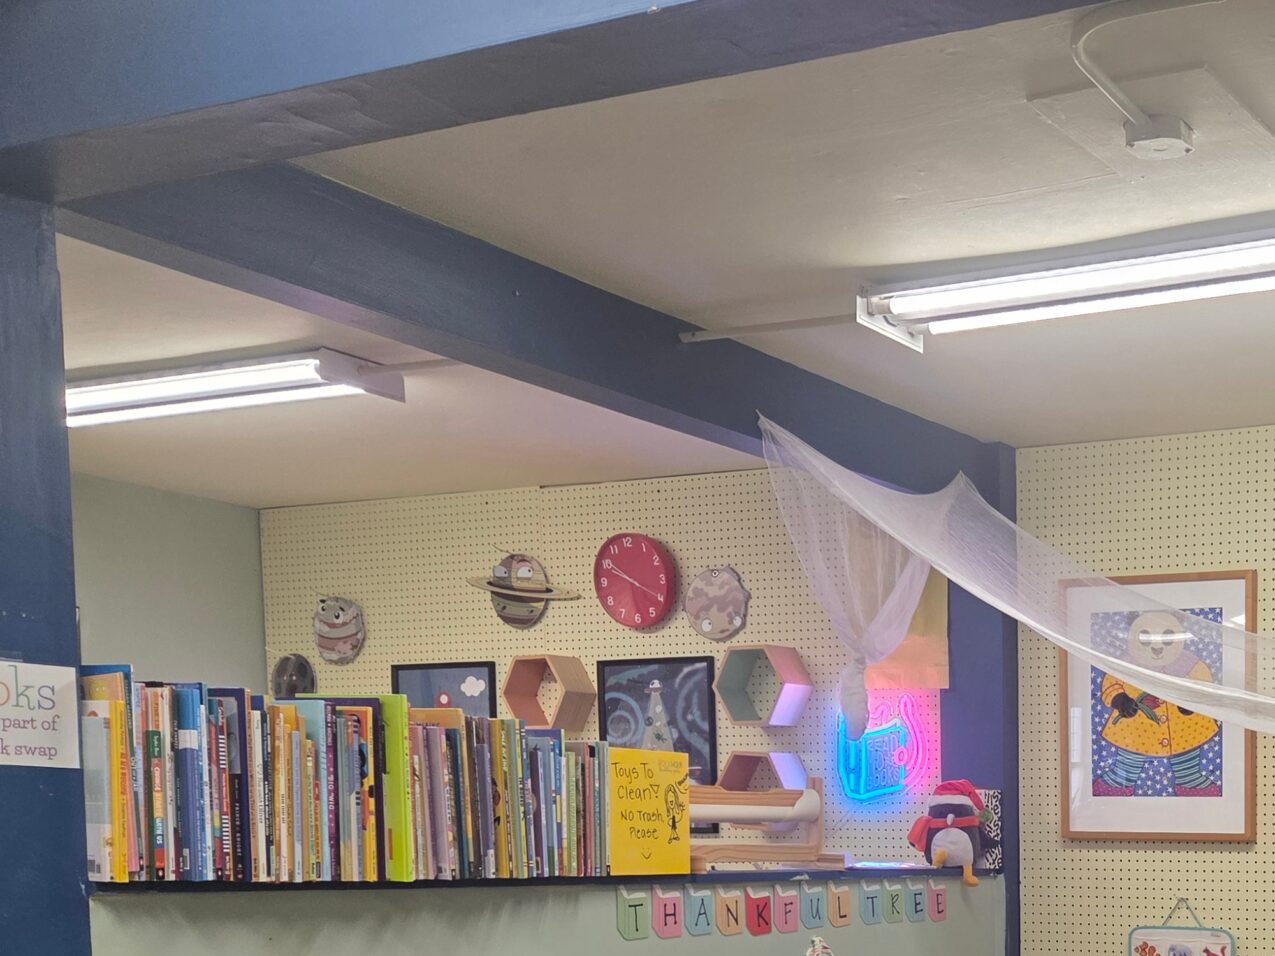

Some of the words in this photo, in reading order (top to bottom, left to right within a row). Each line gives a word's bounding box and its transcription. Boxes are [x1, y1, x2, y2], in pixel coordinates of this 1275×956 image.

[622, 536, 632, 548] 12
[609, 545, 619, 555] 11
[641, 543, 647, 552] 1
[602, 559, 613, 569] 10
[652, 556, 660, 565] 2
[600, 577, 608, 587] 9
[659, 574, 666, 584] 3
[607, 596, 614, 606] 8
[657, 593, 664, 602] 4
[619, 609, 626, 619] 7
[649, 607, 656, 618] 5
[634, 614, 642, 623] 6
[1, 716, 37, 732] part
[40, 714, 61, 731] of
[14, 744, 58, 761] swap
[610, 761, 640, 784] Toys
[639, 762, 655, 779] To
[155, 817, 163, 835] WITH
[156, 835, 163, 845] US
[628, 896, 848, 932] THANKFUL
[866, 892, 945, 918] TREE
